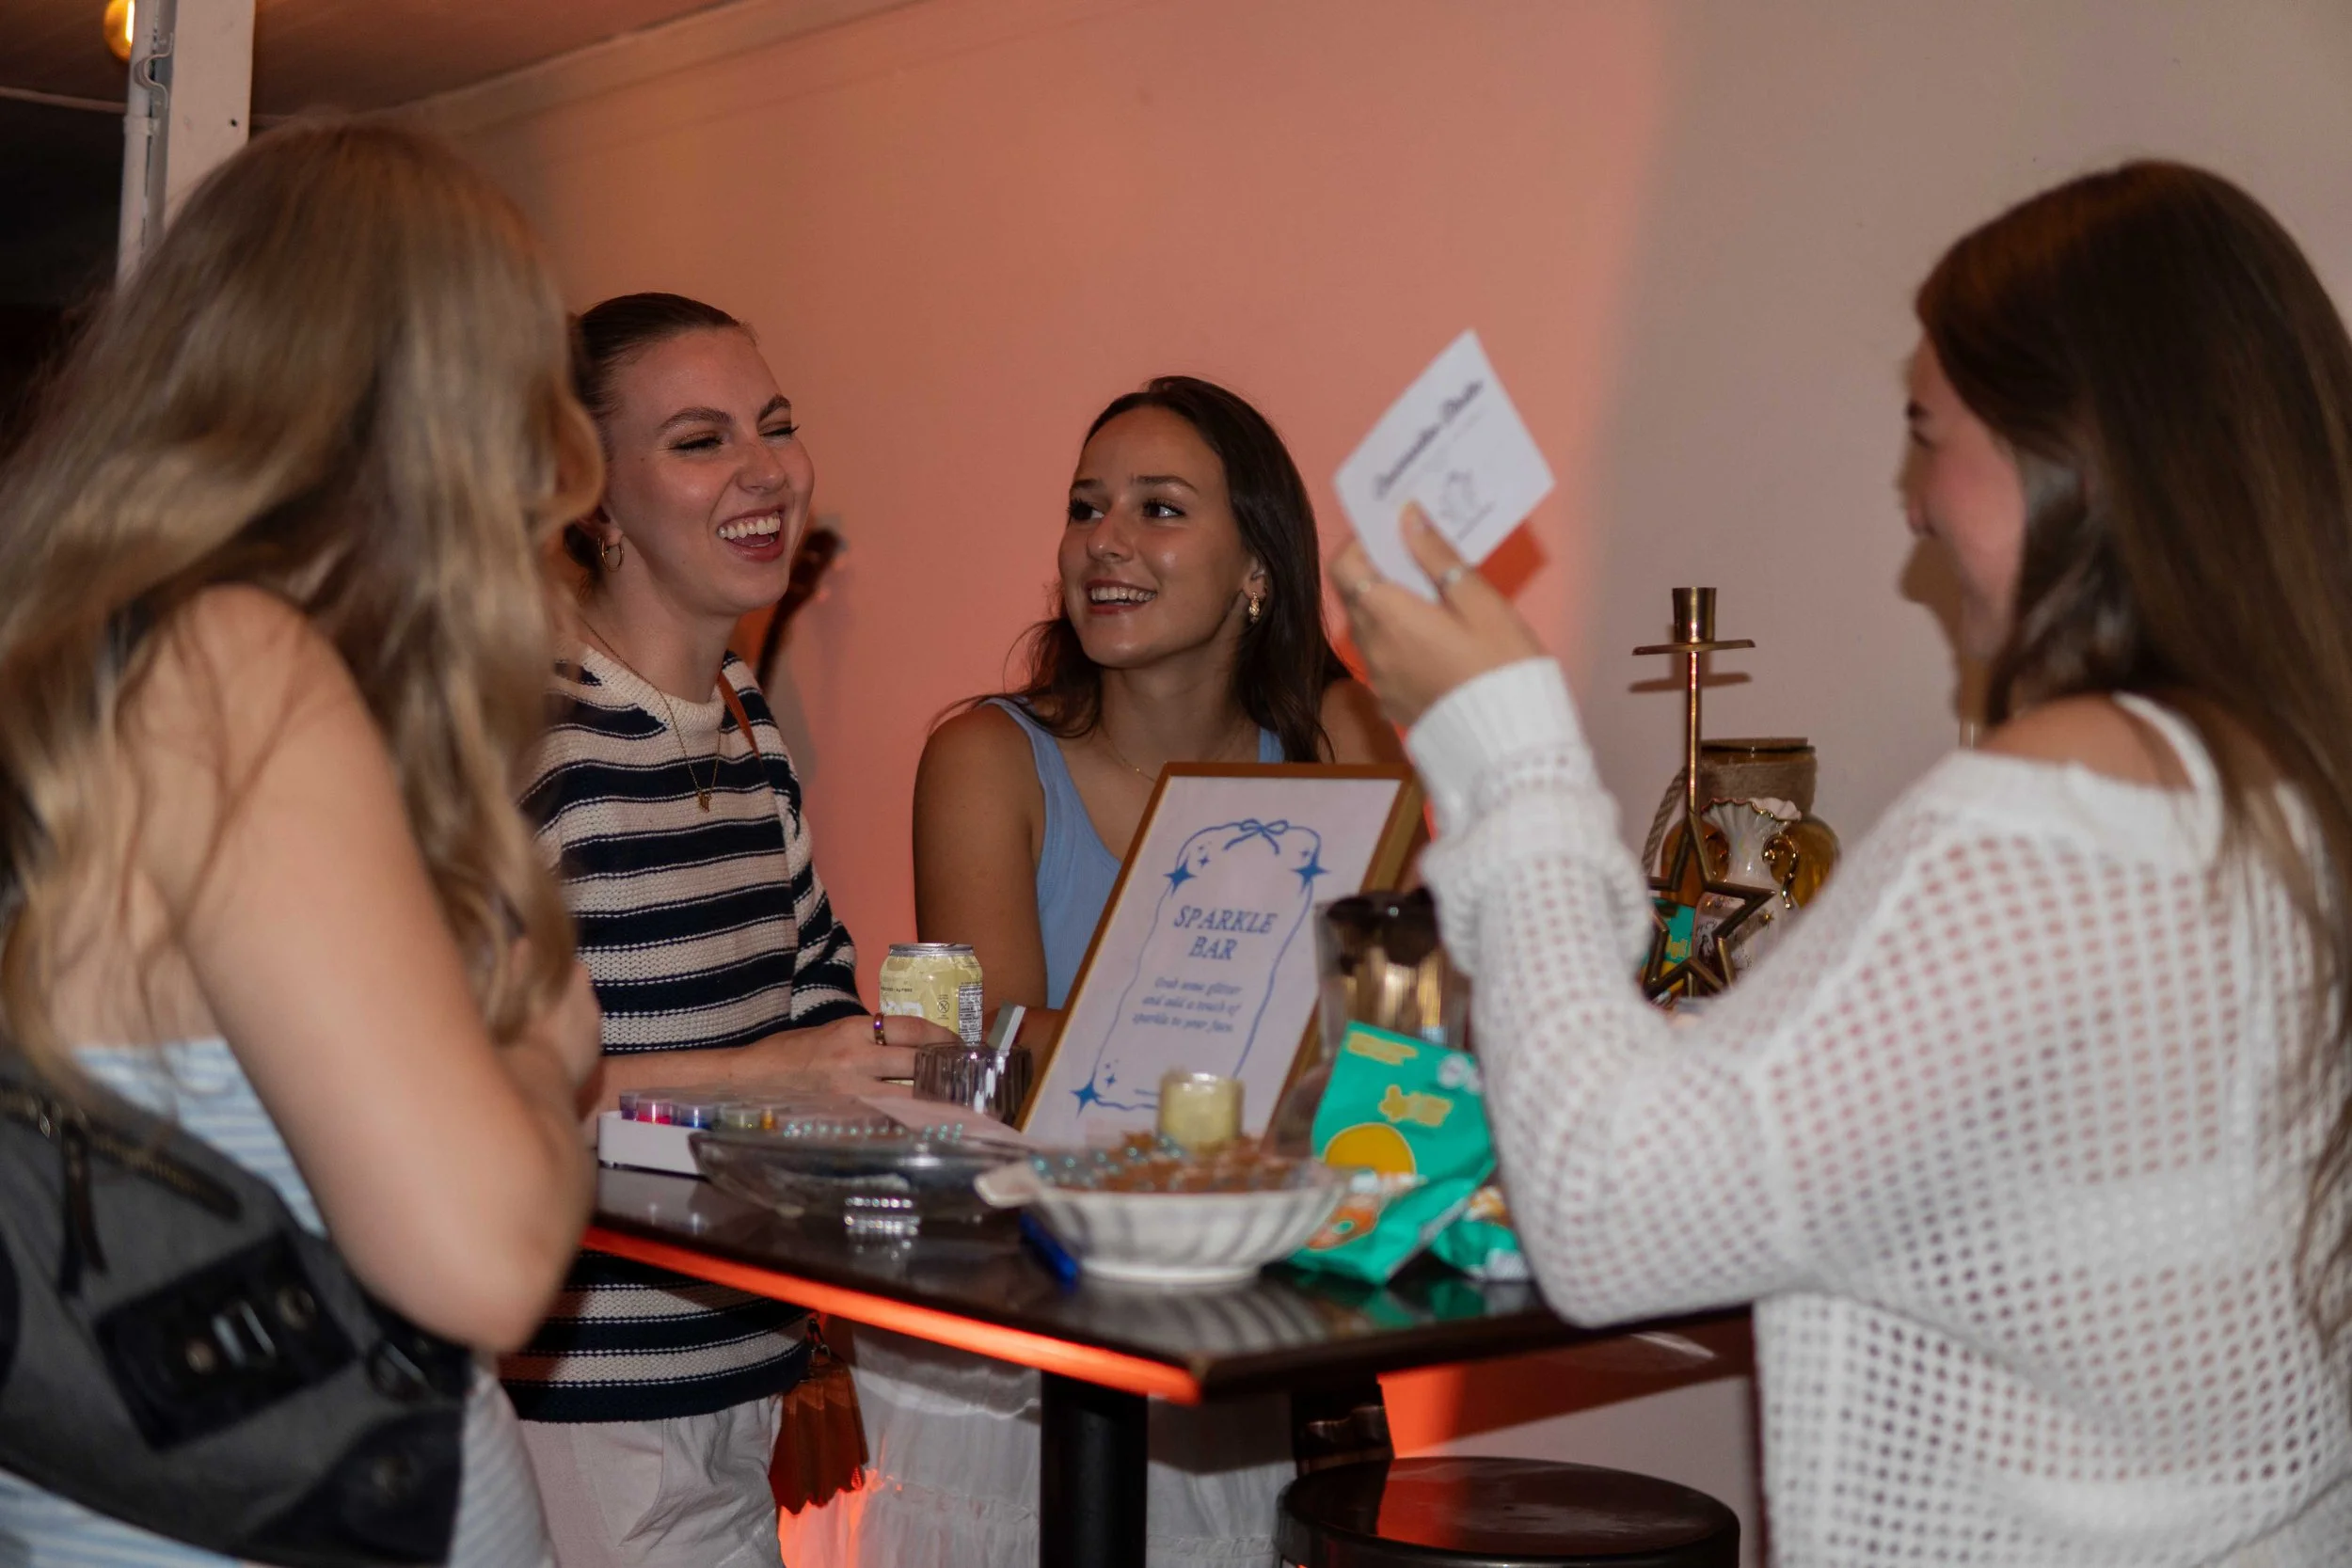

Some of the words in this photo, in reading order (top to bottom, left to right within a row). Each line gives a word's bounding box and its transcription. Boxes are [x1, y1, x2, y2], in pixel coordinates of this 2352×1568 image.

[1173, 905, 1279, 934] SPARKLE
[1188, 936, 1238, 960] BAR
[1181, 981, 1204, 991] some
[1205, 981, 1243, 997] glitter
[1141, 993, 1165, 1006] and
[1164, 996, 1187, 1008] add
[1196, 1000, 1225, 1012] touch
[1227, 1002, 1243, 1018] of
[1132, 1012, 1169, 1026] sparkle
[1170, 1017, 1183, 1026] to
[1183, 1019, 1208, 1031] your
